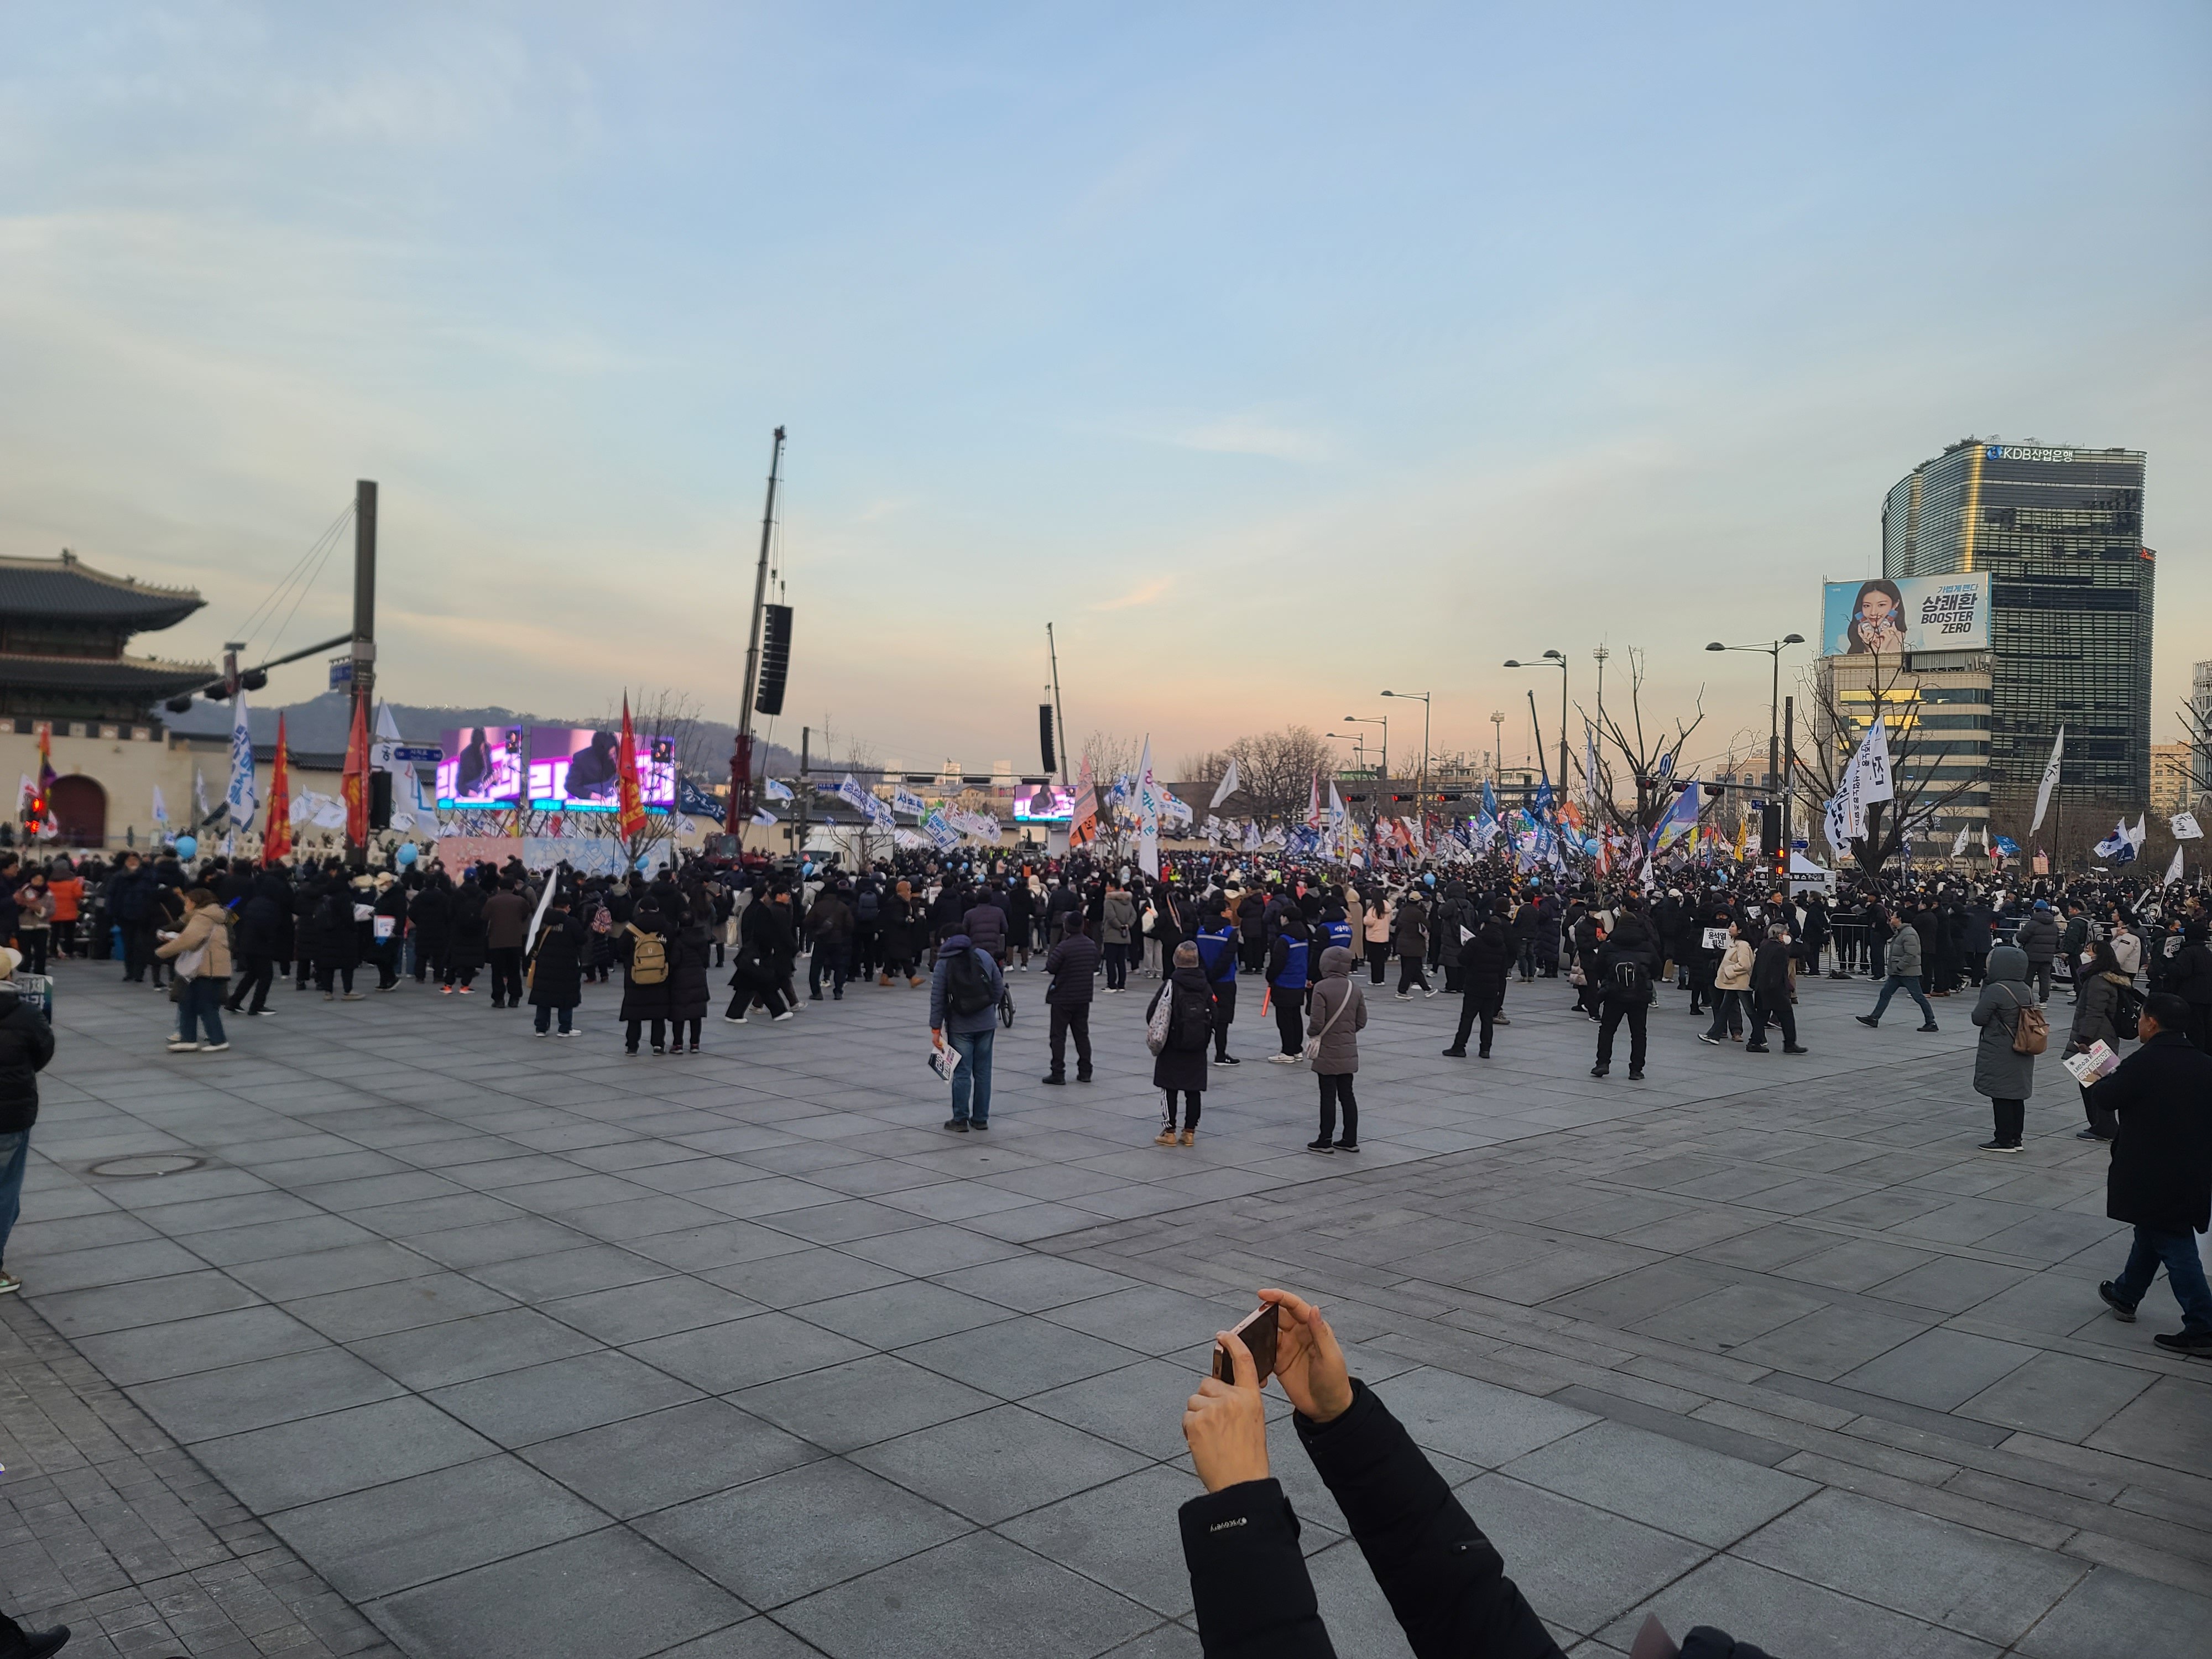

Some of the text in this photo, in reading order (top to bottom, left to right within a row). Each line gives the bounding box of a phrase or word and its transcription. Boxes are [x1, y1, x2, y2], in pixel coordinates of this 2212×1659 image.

[2004, 447, 2073, 462] KDB산업은행
[1922, 593, 1978, 613] 상쾌환
[1921, 611, 1974, 624] BOOSTER
[1940, 622, 1971, 634] ZERO
